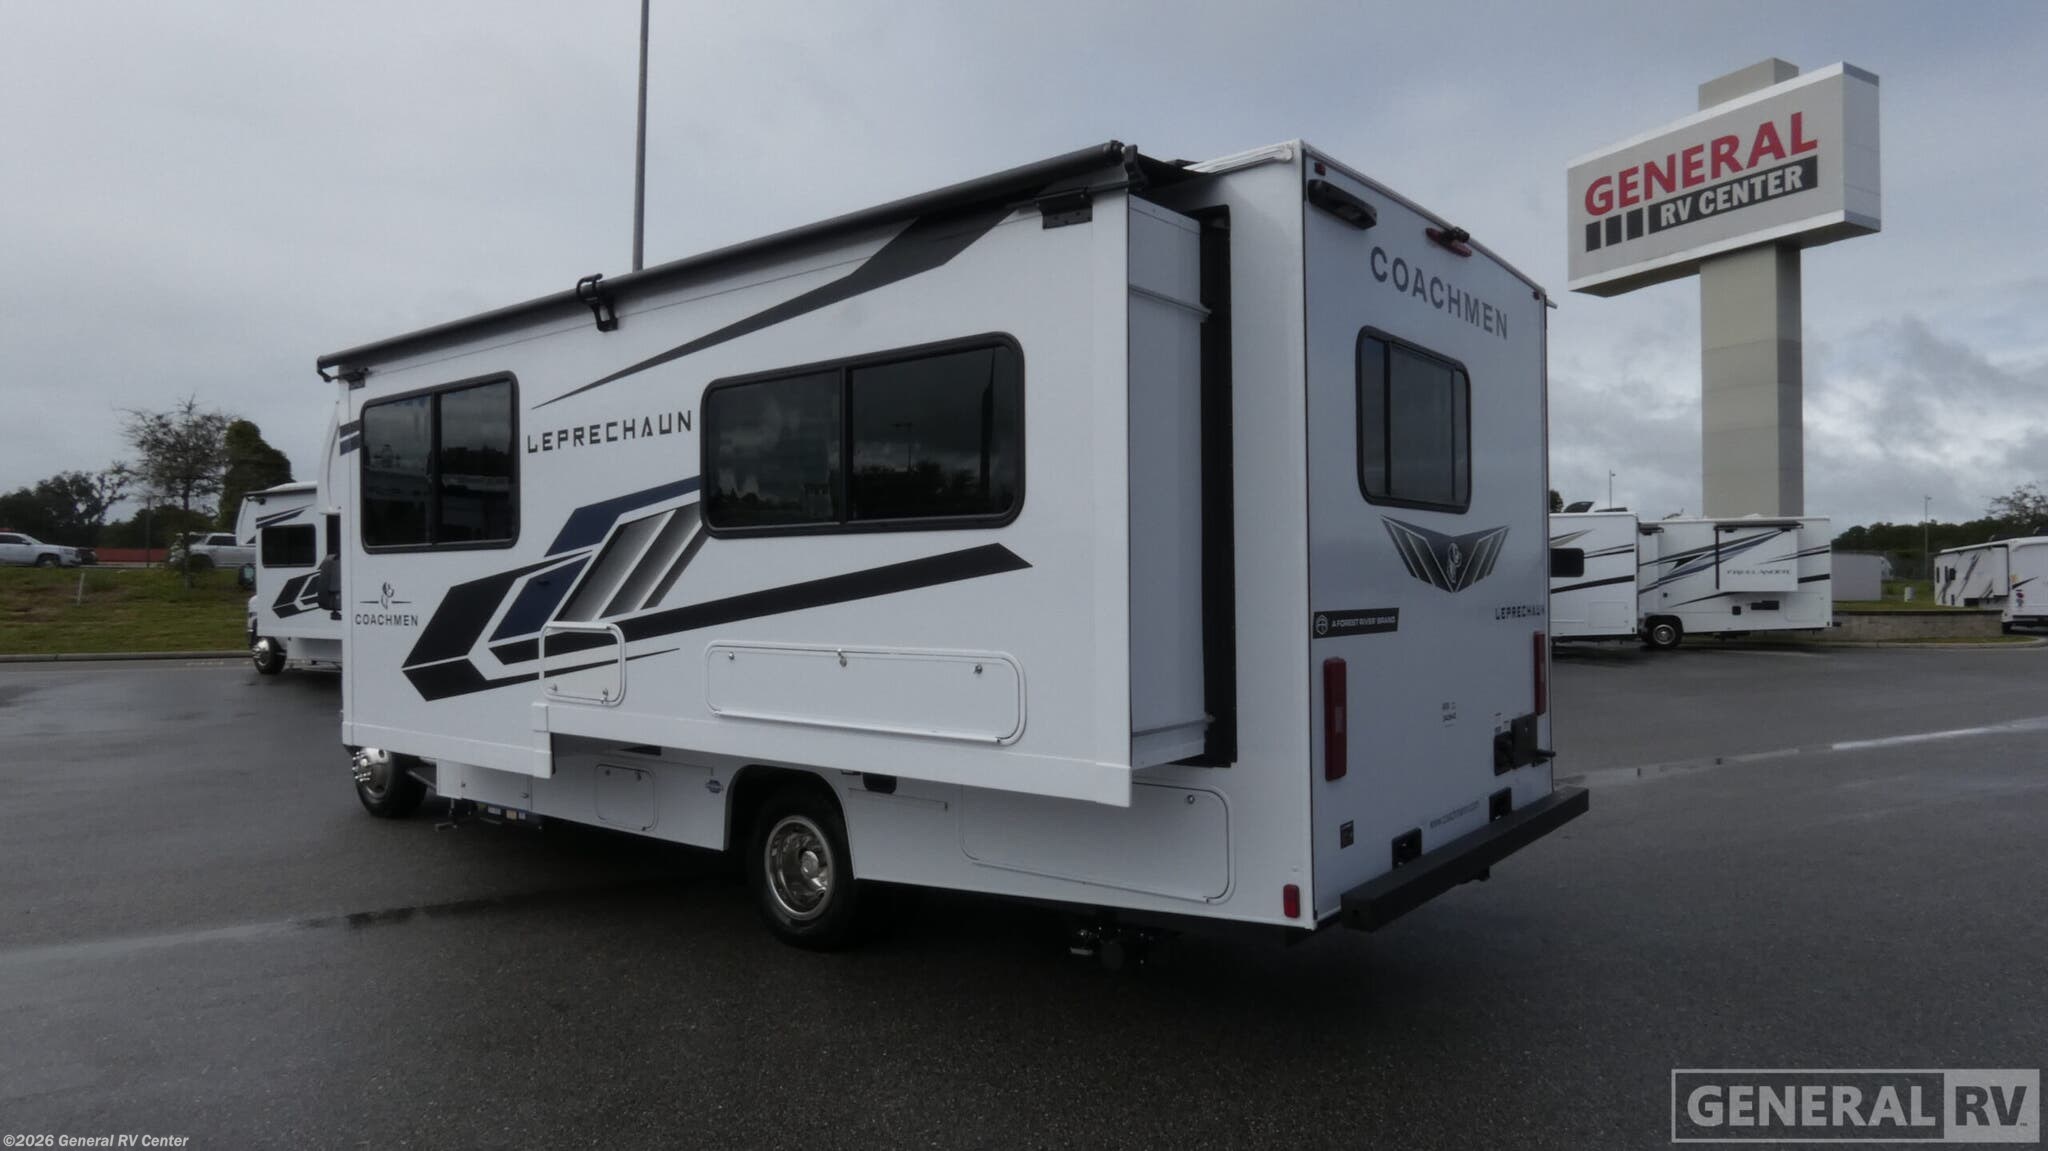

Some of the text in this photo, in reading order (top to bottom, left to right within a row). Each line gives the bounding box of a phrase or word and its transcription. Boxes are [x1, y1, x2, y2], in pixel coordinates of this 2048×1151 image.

[1585, 111, 1818, 217] GENERAL
[1660, 164, 1804, 228] RV CENTER
[1370, 246, 1508, 340] COACHMEN
[527, 410, 692, 454] LEPRECHAUN
[355, 613, 419, 626] COACHMEN
